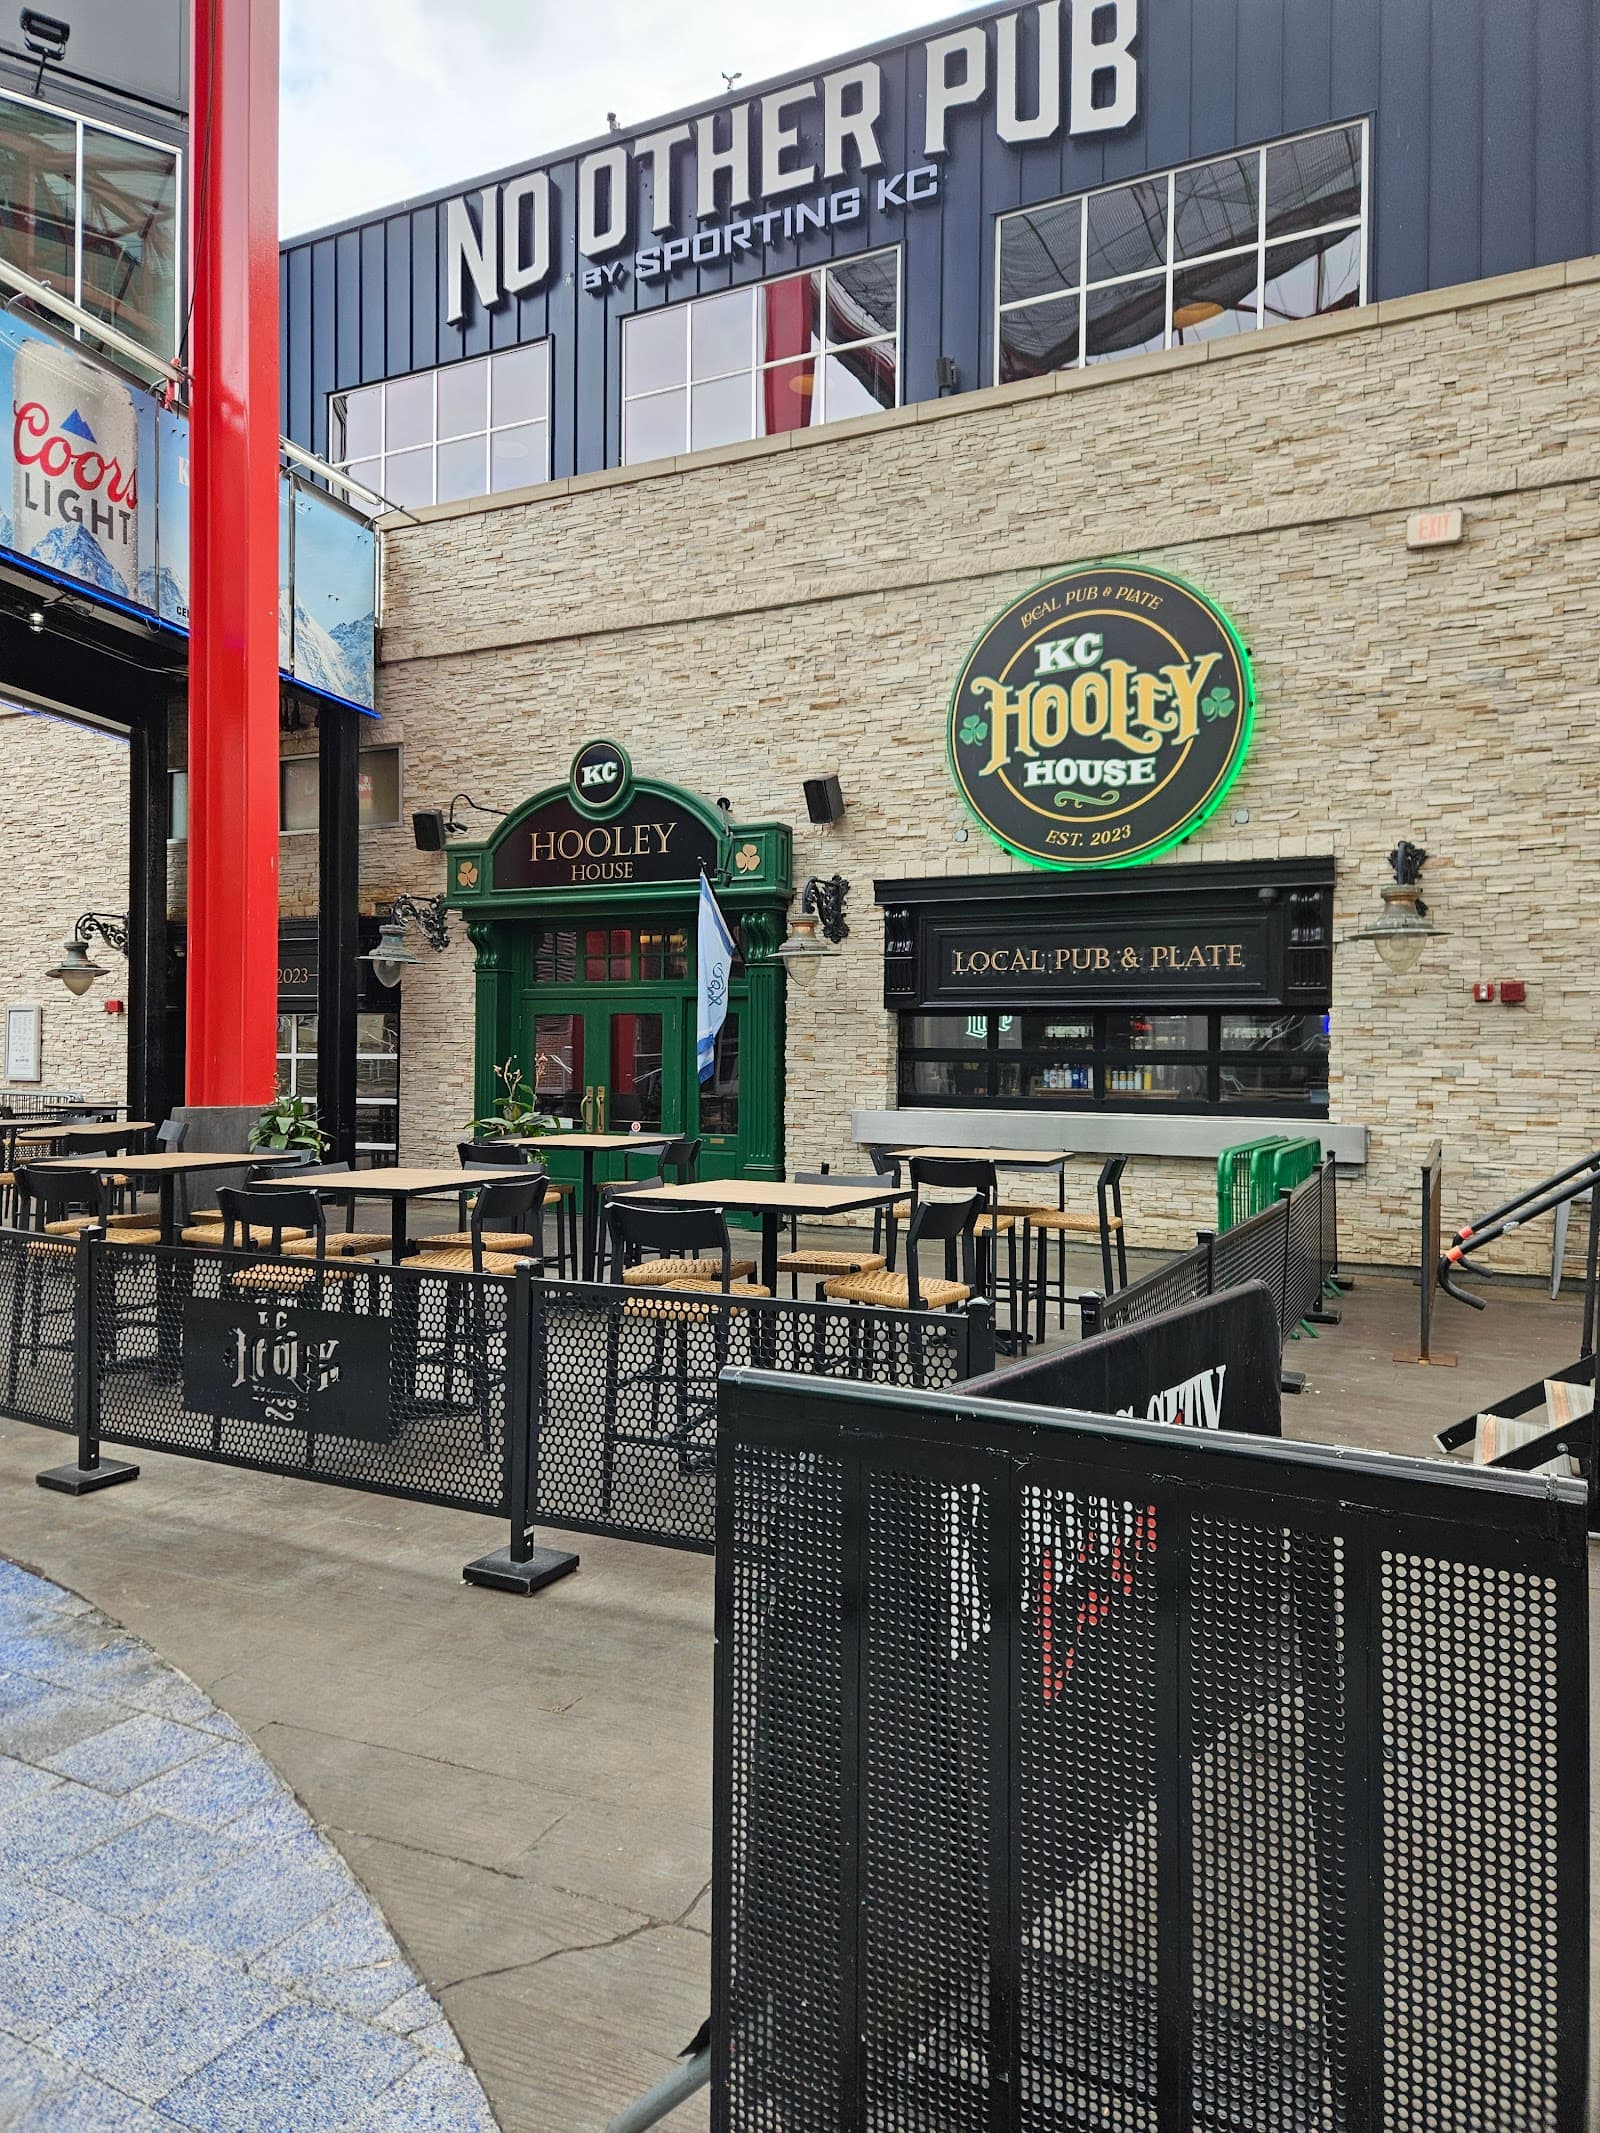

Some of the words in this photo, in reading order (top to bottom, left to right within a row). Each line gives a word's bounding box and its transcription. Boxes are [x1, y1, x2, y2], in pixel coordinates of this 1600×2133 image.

[447, 169, 550, 326] NO
[579, 61, 884, 257] OTHER
[924, 0, 1138, 156] PUB
[582, 262, 622, 291] BY
[636, 191, 860, 280] SPORTING
[877, 164, 938, 205] KC
[13, 400, 138, 510] Coors
[25, 472, 132, 545] LIGHT
[1419, 513, 1450, 538] EXIT
[1020, 597, 1061, 629] LOCAL
[1066, 586, 1098, 606] PUB
[1102, 586, 1112, 597] &
[1115, 586, 1163, 610] PLATE
[1034, 633, 1103, 676] KC
[971, 652, 1223, 776] HOOLEY
[581, 761, 618, 788] KC
[1024, 758, 1156, 788] HOUSE
[529, 822, 678, 862] HOOLEY
[1045, 829, 1083, 846] EST.
[1089, 824, 1132, 846] 2023
[571, 862, 633, 881] HOUSE
[277, 968, 308, 984] 2023
[955, 950, 1045, 972] LOCAL
[1055, 948, 1110, 970] PUB
[1120, 948, 1141, 969] &
[1152, 943, 1243, 968] PLATE
